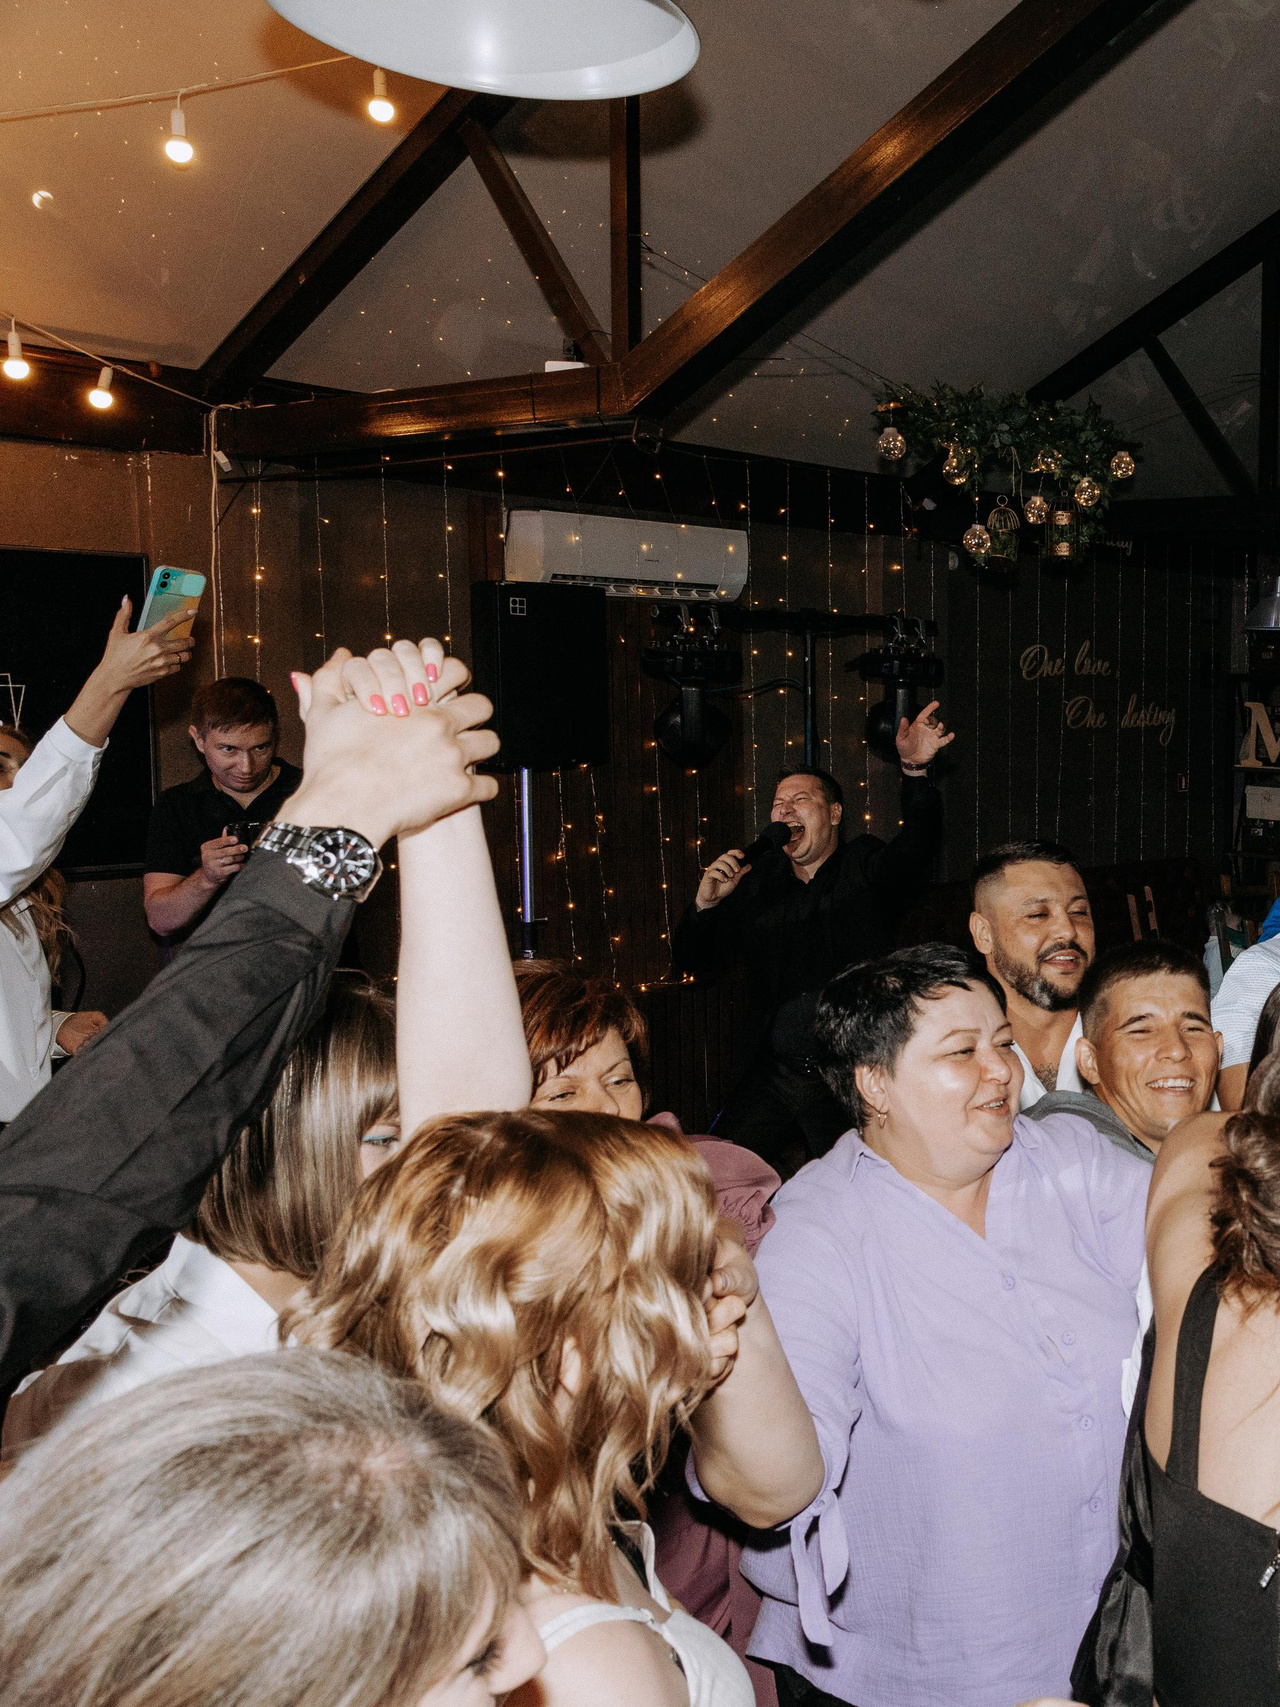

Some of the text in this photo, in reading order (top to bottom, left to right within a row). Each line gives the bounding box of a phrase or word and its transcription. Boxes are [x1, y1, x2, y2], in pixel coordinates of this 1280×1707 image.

[1020, 644, 1065, 681] One
[1066, 693, 1176, 746] One destiny
